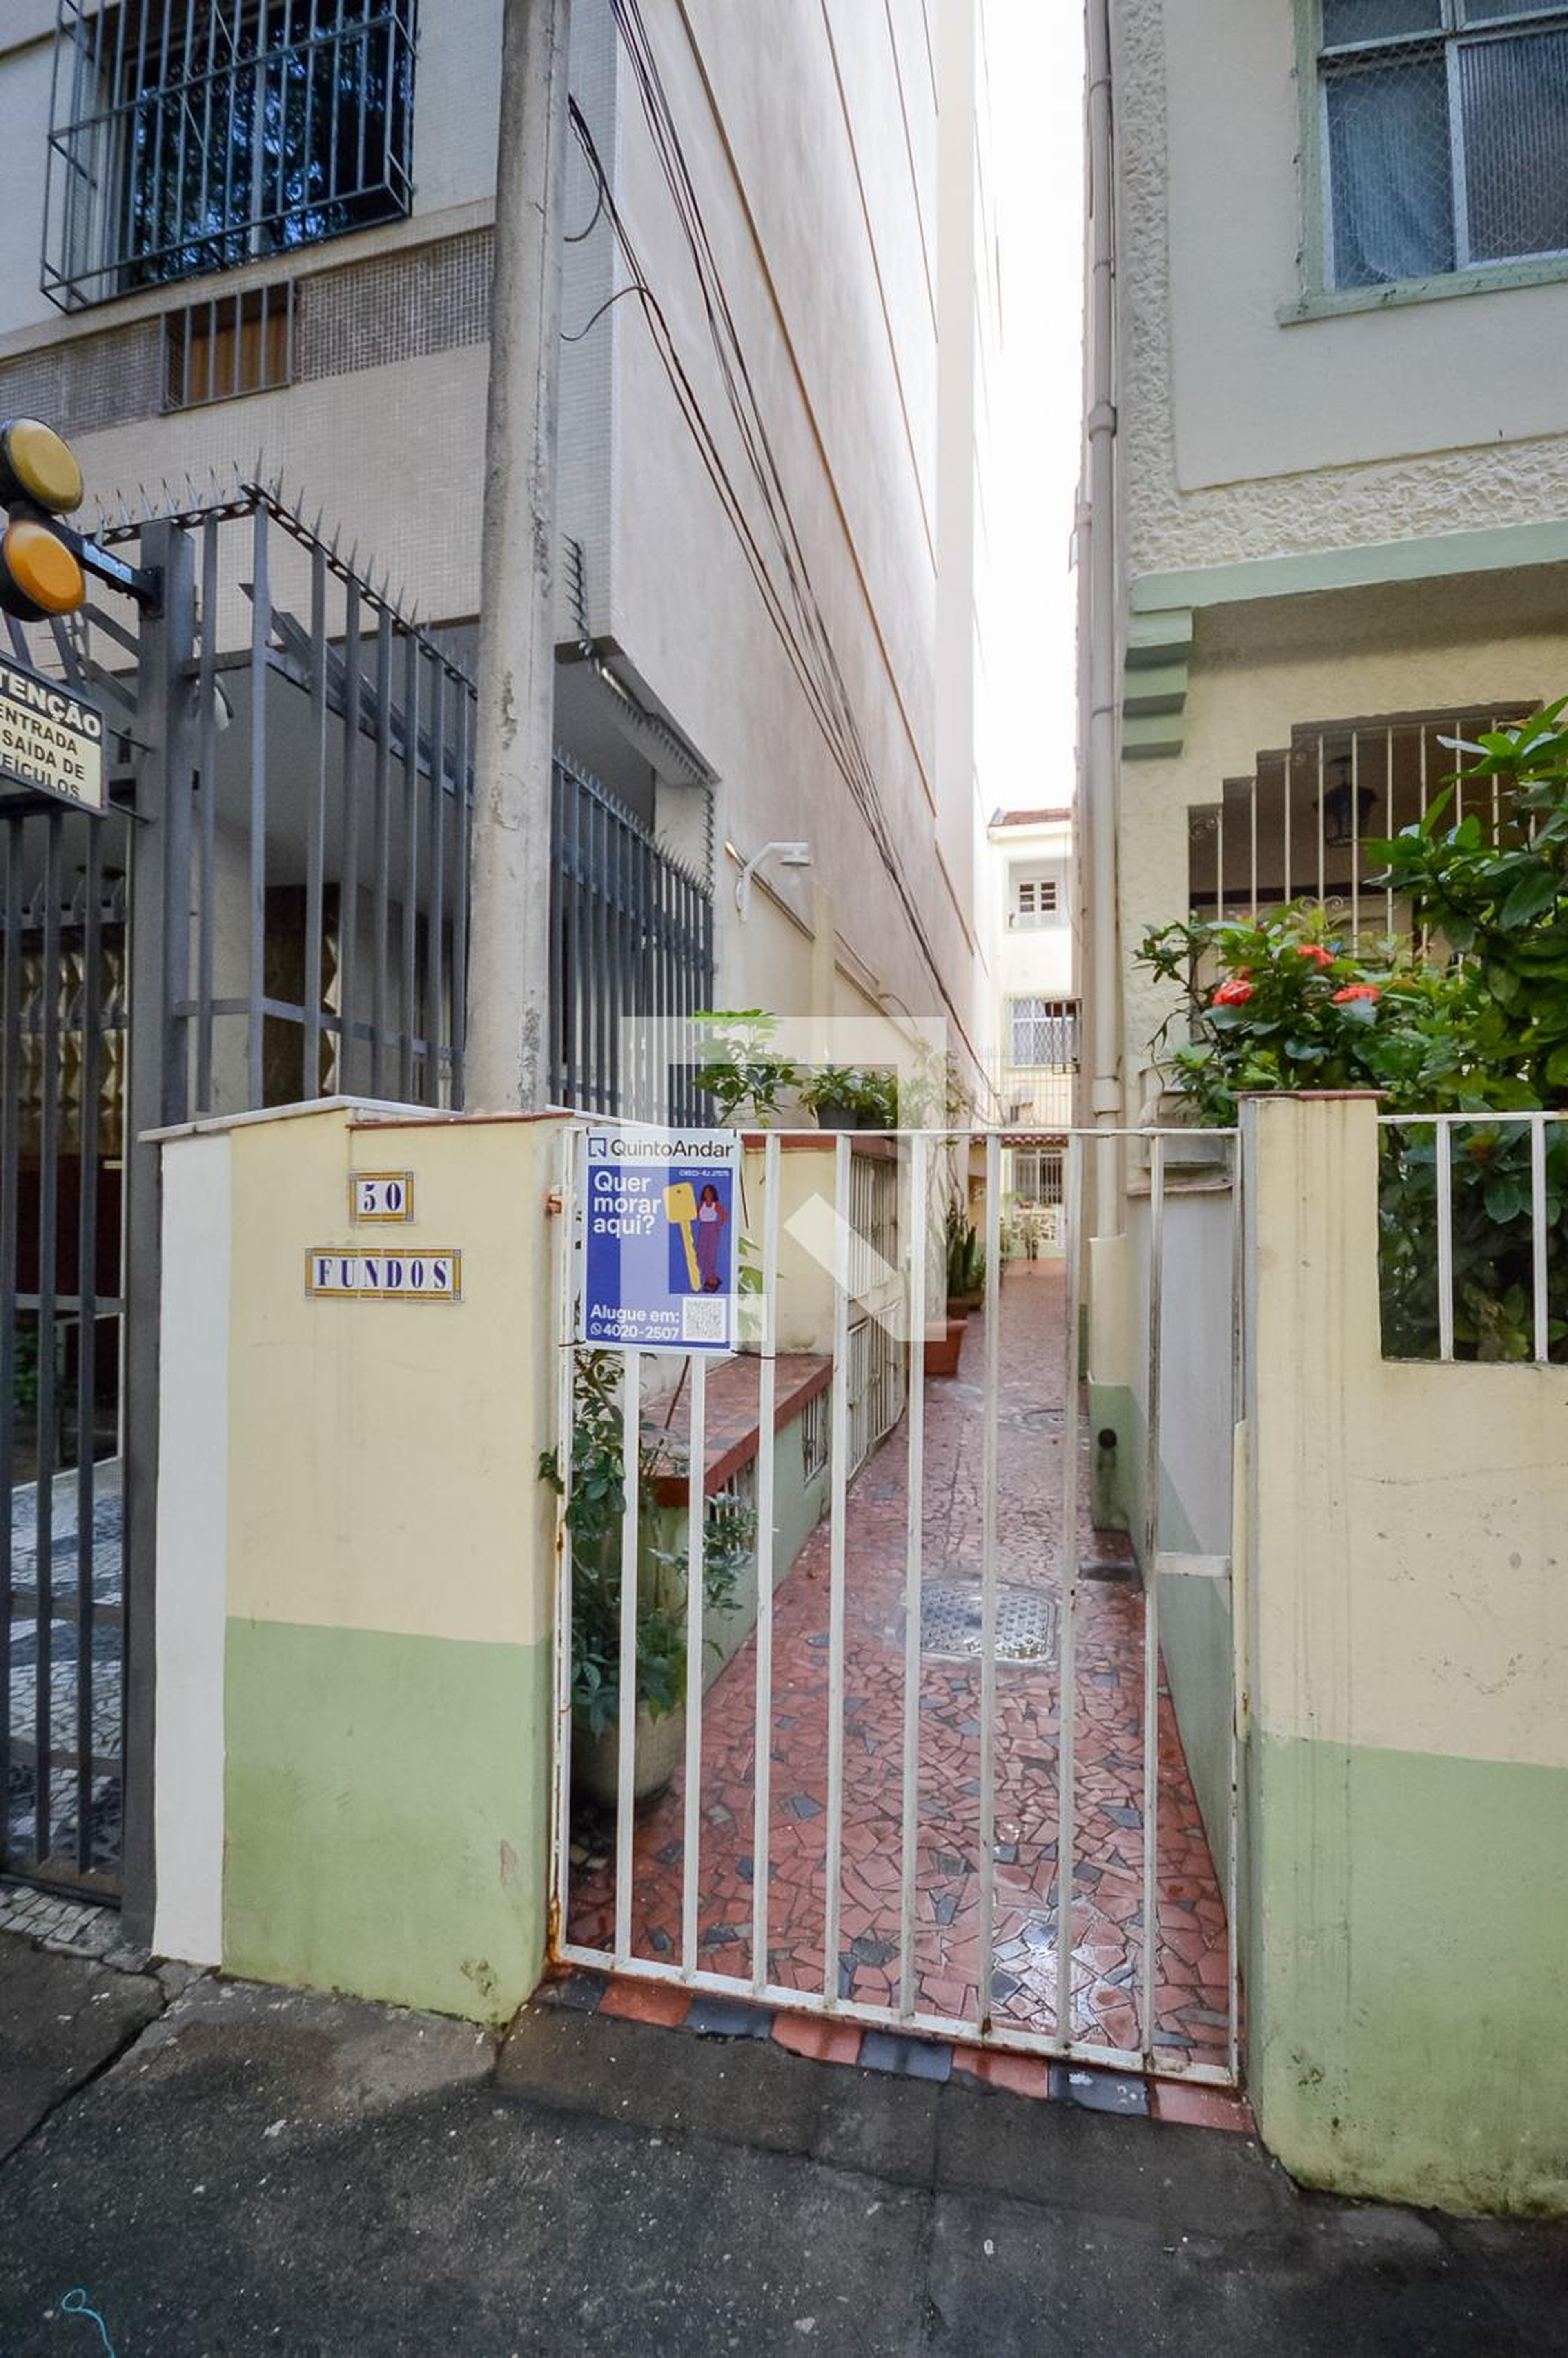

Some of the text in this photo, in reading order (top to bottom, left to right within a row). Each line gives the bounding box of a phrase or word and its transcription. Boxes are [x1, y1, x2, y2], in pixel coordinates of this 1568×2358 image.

[2, 729, 85, 780] SAÍDA DE
[0, 752, 80, 799] EÍCULOS
[611, 1138, 734, 1158] QuintoAndar
[594, 1171, 650, 1193] Quer
[364, 1182, 401, 1211] 50
[593, 1195, 662, 1214] morar
[593, 1215, 655, 1238] aqui?
[318, 1259, 447, 1289] FUNDOS
[590, 1305, 679, 1324] Alugue em:
[604, 1323, 679, 1339] 4020-2507
